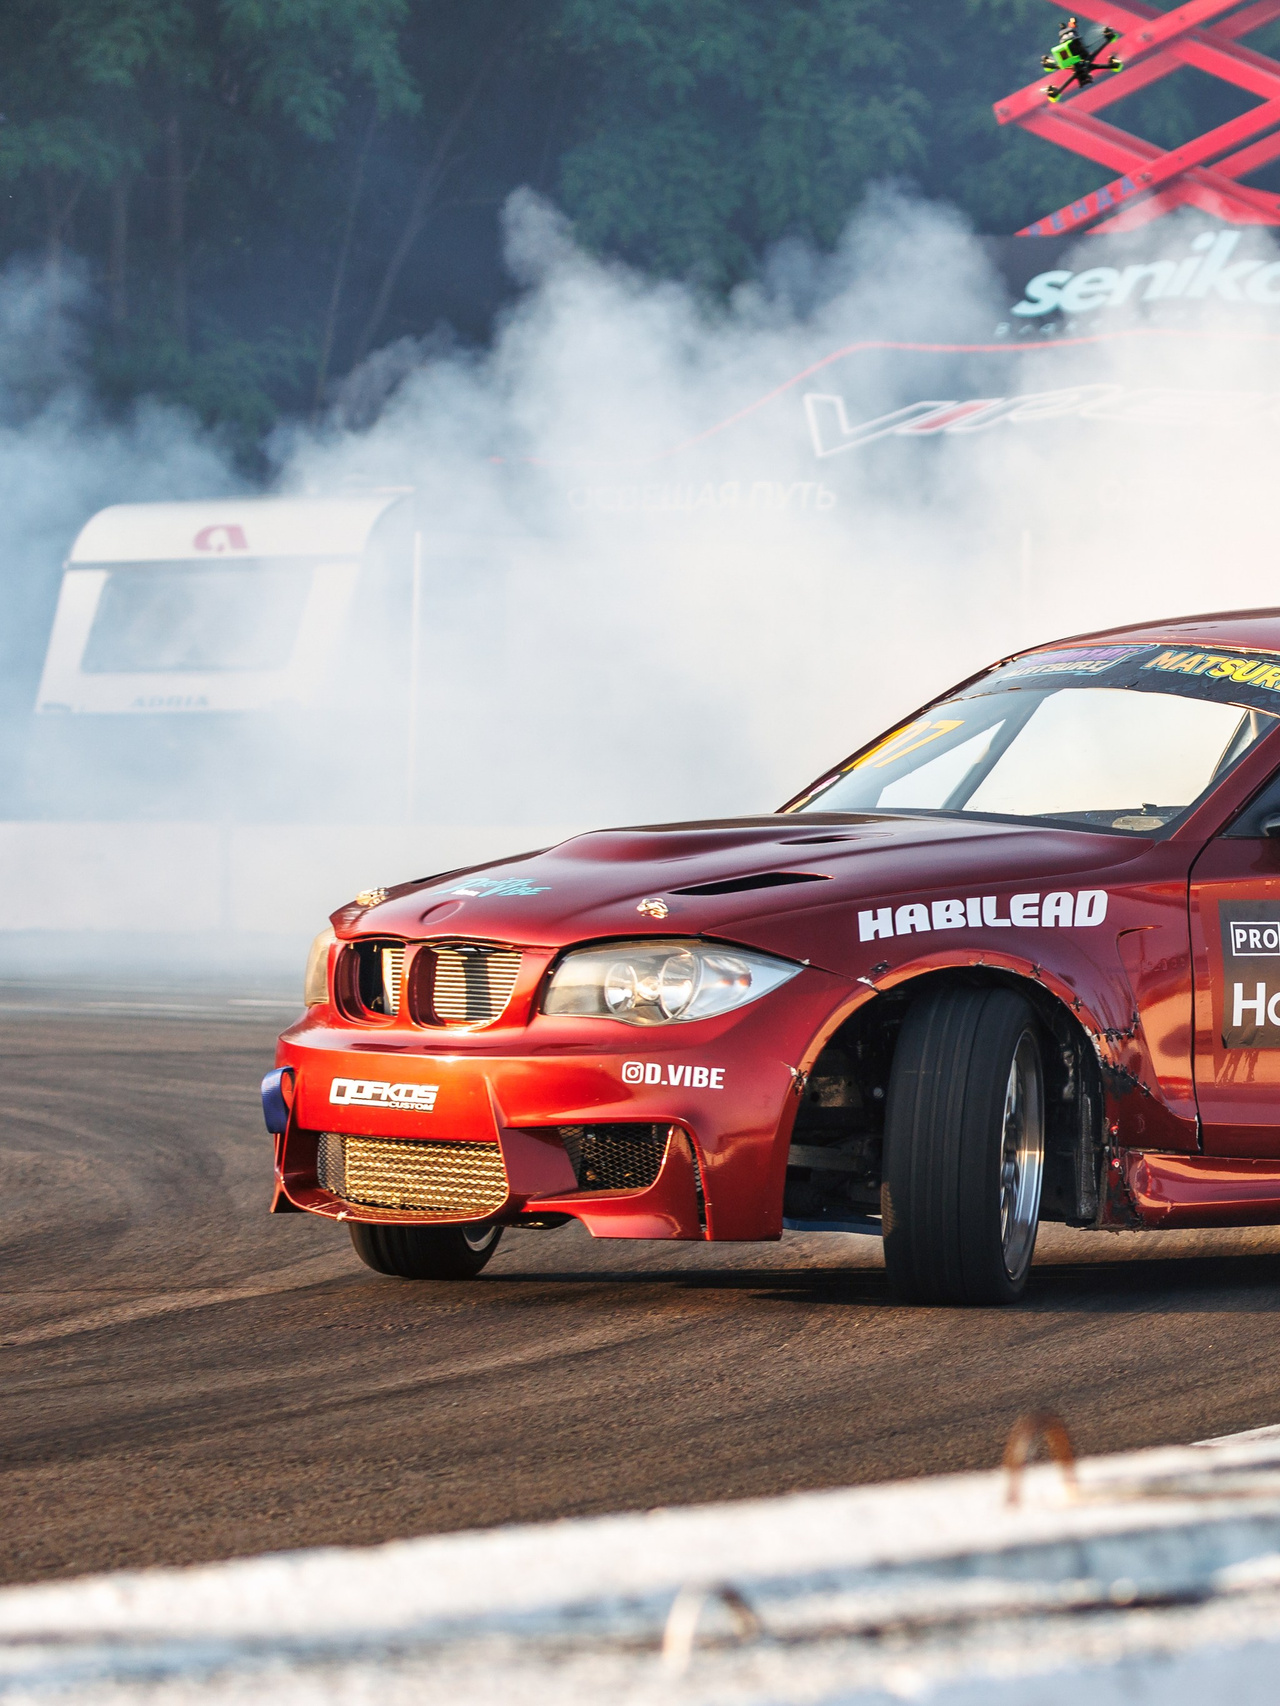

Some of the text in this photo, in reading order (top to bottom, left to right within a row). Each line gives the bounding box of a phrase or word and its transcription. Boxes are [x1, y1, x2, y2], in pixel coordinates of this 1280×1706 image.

[749, 481, 838, 512] ПУТЬ
[857, 889, 1109, 942] HABILEAD
[388, 1101, 434, 1112] CUSTOM
